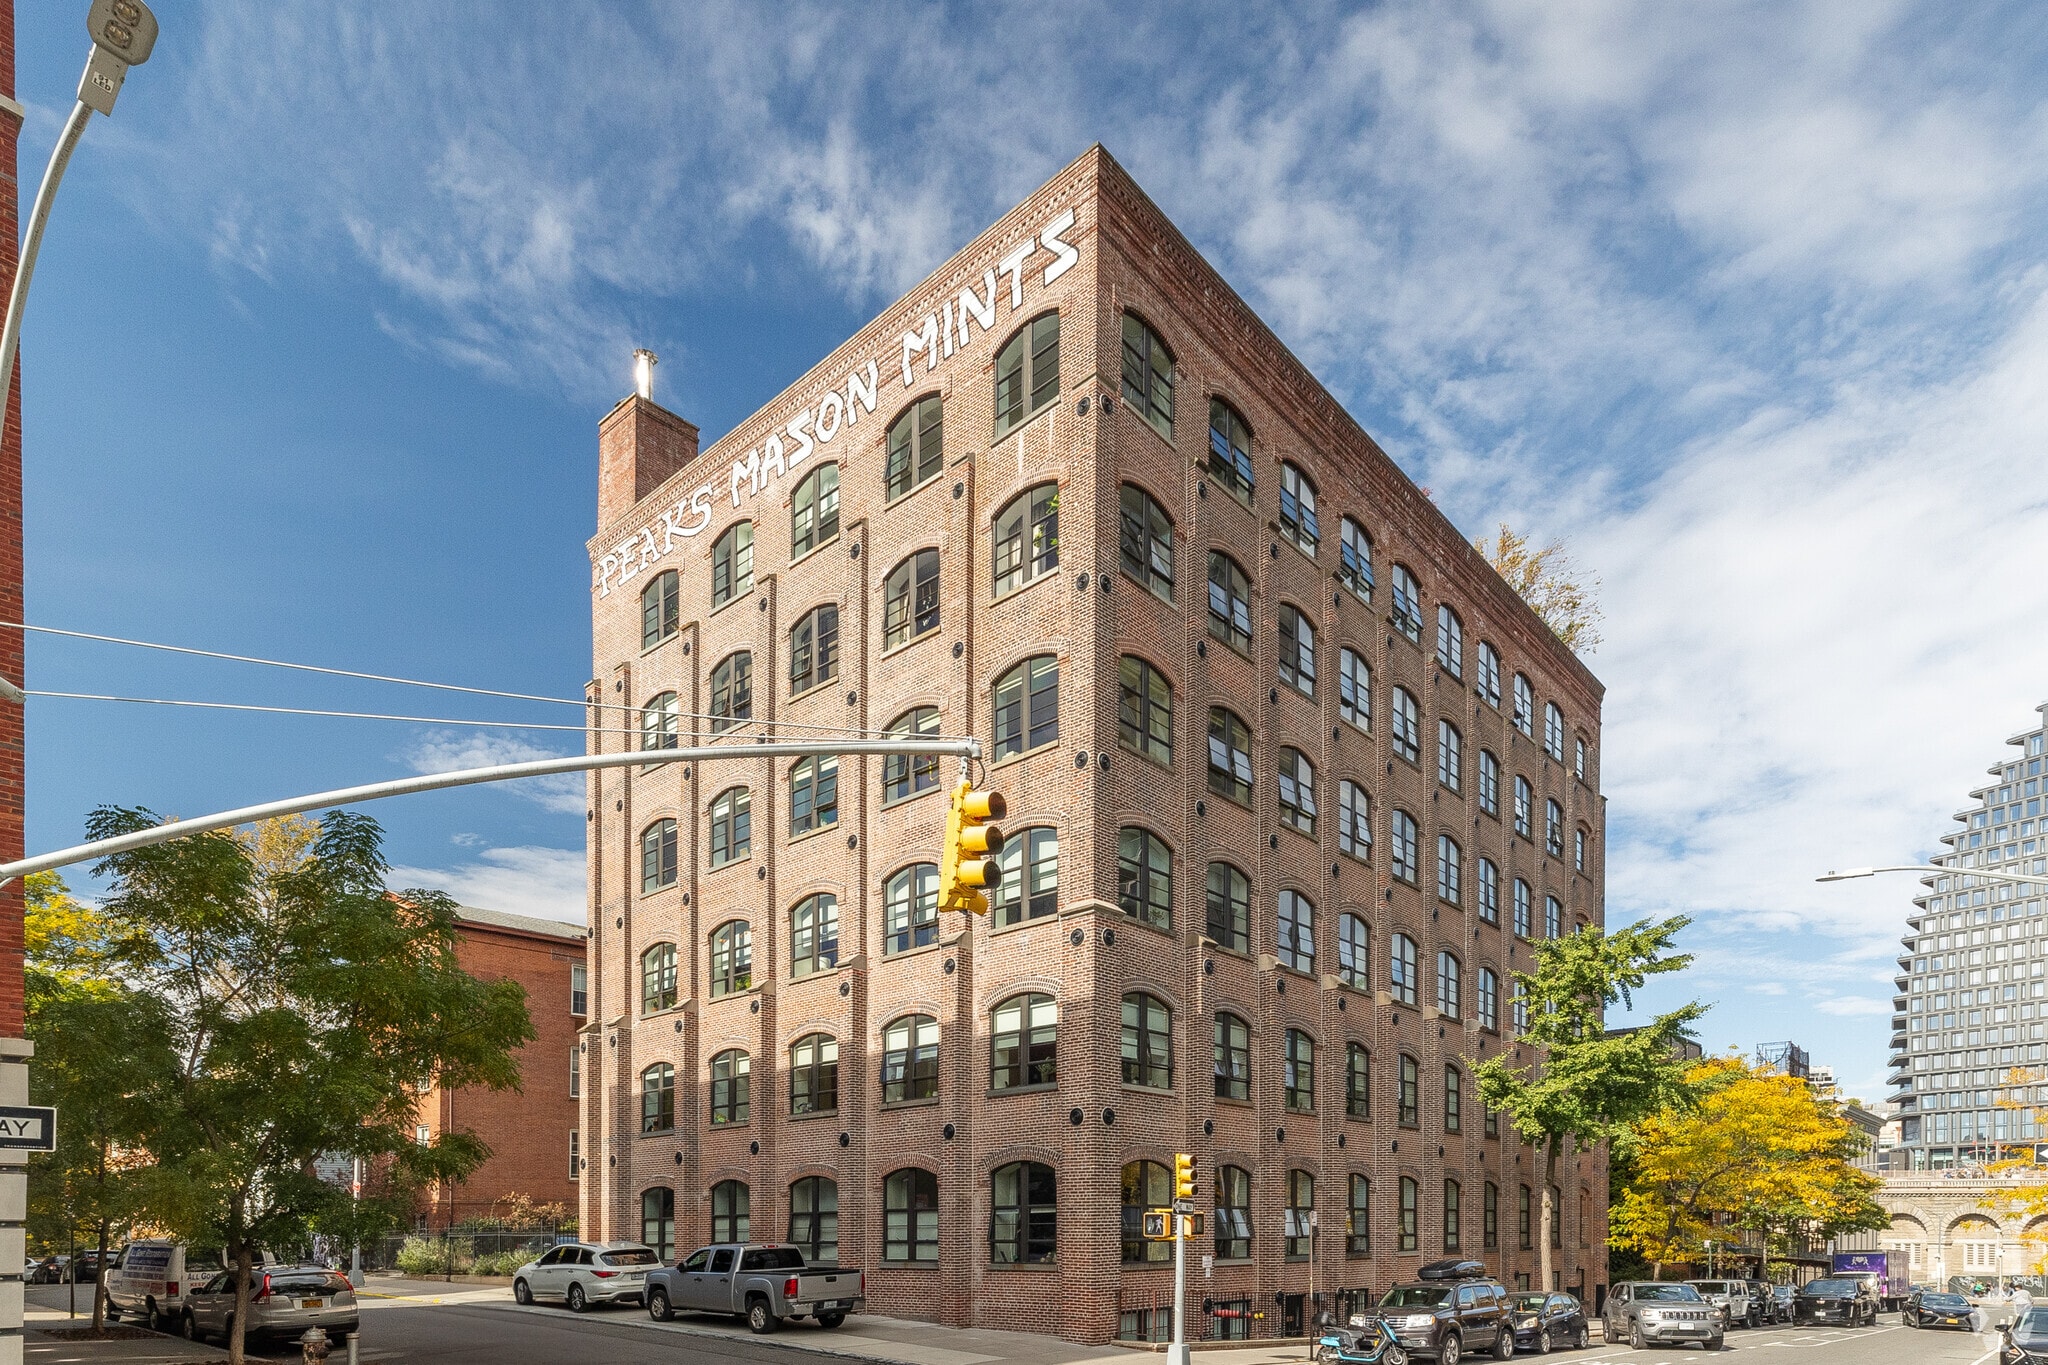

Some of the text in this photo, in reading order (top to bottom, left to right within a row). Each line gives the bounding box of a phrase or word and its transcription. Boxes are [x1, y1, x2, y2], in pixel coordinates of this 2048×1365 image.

[93, 77, 111, 92] LED
[598, 208, 1079, 598] PEAKS MASON MINTS
[201, 1272, 215, 1280] GON
